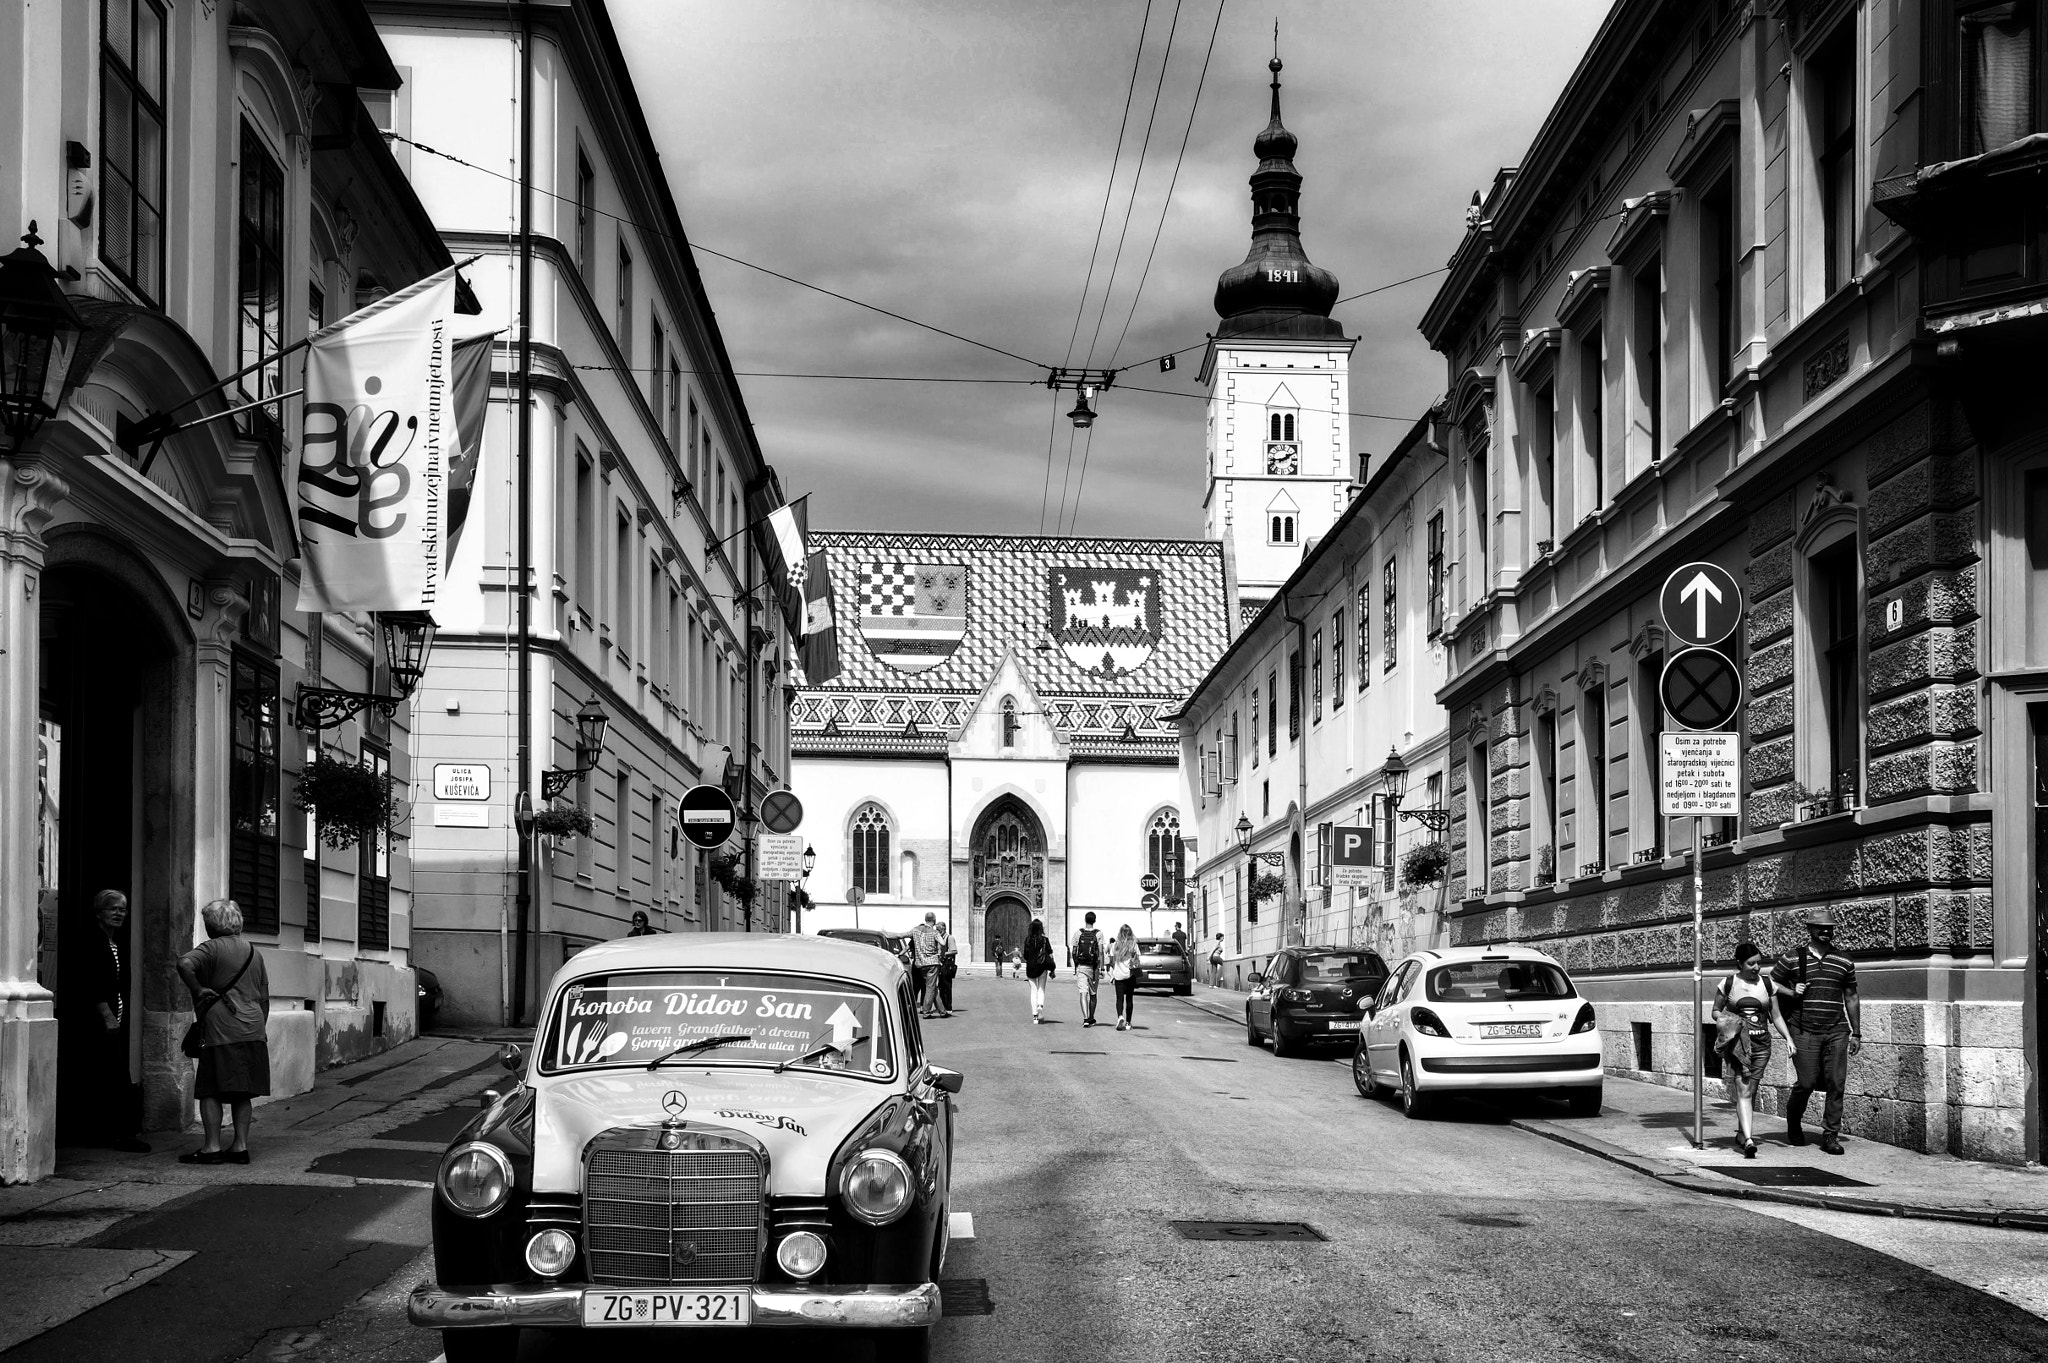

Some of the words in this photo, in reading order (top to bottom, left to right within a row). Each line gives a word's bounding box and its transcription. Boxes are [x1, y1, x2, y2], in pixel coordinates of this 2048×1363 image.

[1164, 359, 1170, 369] 3
[1892, 601, 1898, 621] 6
[1675, 737, 1690, 745] Osim
[1703, 737, 1726, 746] potrebe
[1677, 769, 1695, 778] petak
[1667, 791, 1696, 800] nedjeljom
[1344, 834, 1361, 858] P
[1141, 879, 1158, 887] STOP
[571, 997, 653, 1017] konoba
[664, 992, 748, 1016] Didov
[756, 995, 812, 1020] San
[678, 1022, 766, 1037] Grandfather's
[769, 1026, 809, 1039] dream
[1488, 1025, 1499, 1035] ZG
[631, 1036, 672, 1051] Gornji
[768, 1041, 795, 1051] ulica
[714, 1110, 775, 1121] Didov
[756, 1116, 807, 1136] San
[603, 1296, 633, 1321] ZG
[653, 1295, 739, 1321] PV-321
